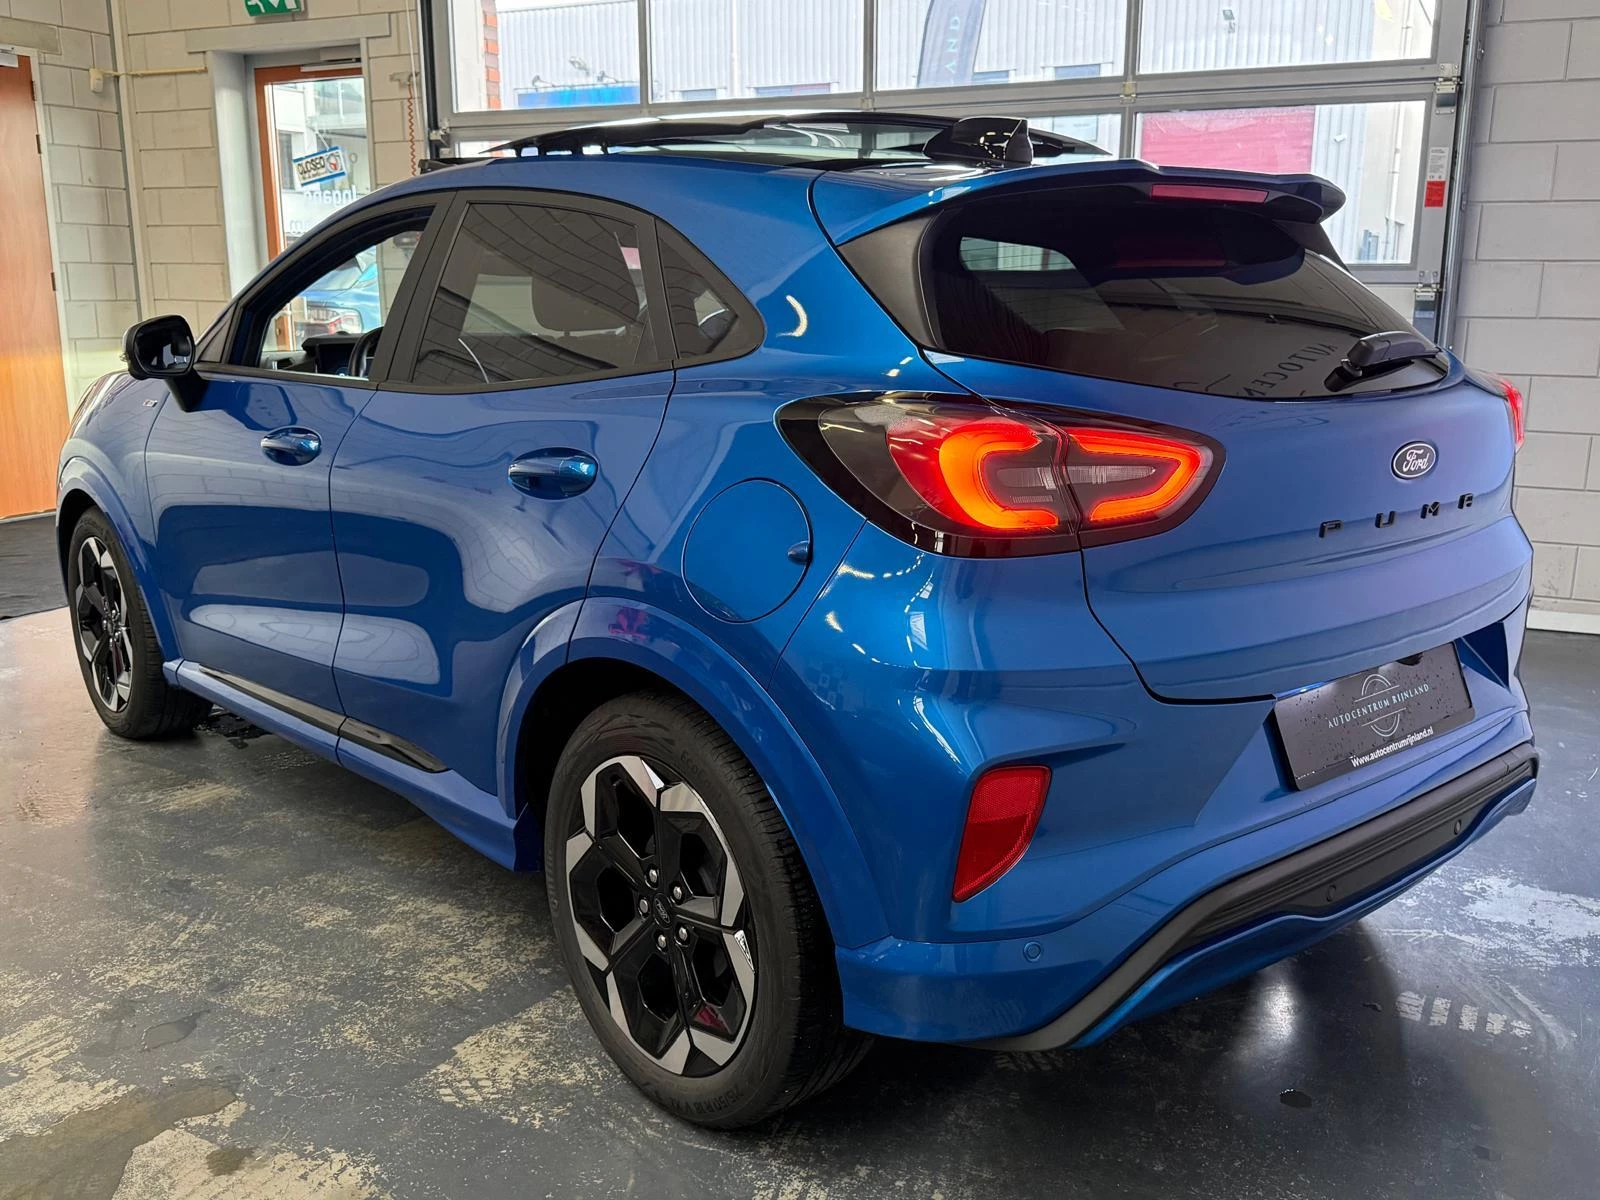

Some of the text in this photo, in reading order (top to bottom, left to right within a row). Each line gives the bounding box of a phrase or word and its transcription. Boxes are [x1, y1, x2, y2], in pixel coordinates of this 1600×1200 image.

[944, 15, 961, 84] AND
[297, 155, 326, 175] CLOSED
[1402, 448, 1431, 473] Ford
[1318, 492, 1474, 539] PUMA
[1327, 683, 1431, 729] AUTOCENTRUM RIJNLAND
